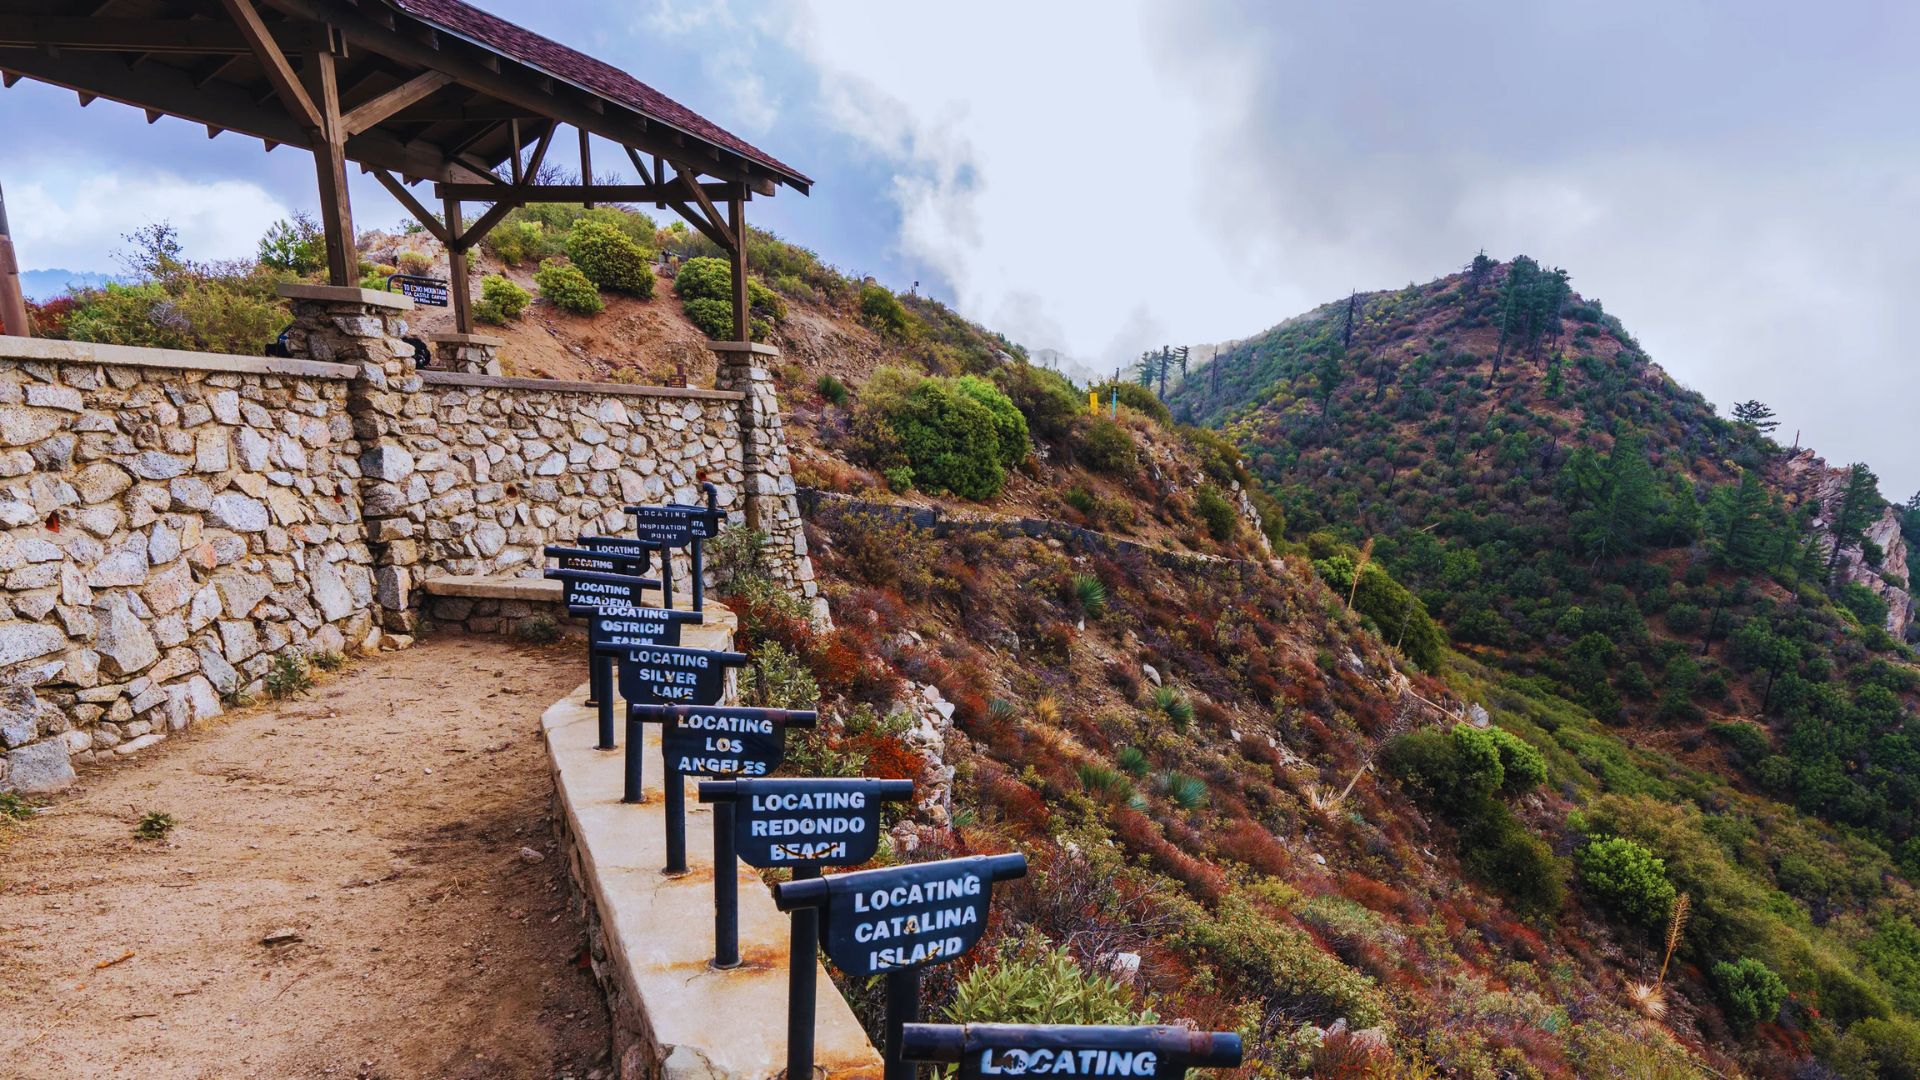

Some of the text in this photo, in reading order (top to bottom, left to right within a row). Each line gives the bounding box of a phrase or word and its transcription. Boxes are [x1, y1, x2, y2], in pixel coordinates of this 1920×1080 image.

[424, 287, 446, 295] MOUNTAIN
[637, 510, 687, 518] LOCATING
[639, 523, 687, 531] INSPIRATION
[596, 545, 640, 555] LOCATING
[567, 558, 613, 569] LOCATING
[574, 581, 631, 596] LOCATING
[569, 593, 633, 608] PASADENA
[598, 606, 669, 620] LOCATING
[600, 620, 664, 635] OSTRICH
[630, 650, 708, 669] LOCATING
[639, 668, 697, 686] SILVER
[652, 685, 694, 700] LAKE
[678, 714, 773, 734] LOCATING
[705, 737, 743, 753] LOS
[677, 757, 767, 776] ANGELES
[751, 791, 865, 812] LOCATING
[751, 816, 865, 837] REDONDO
[770, 841, 846, 861] BEACH
[854, 875, 981, 913] LOCATING
[854, 905, 977, 943] CATALINA
[869, 936, 963, 971] ISLAND
[980, 1048, 1157, 1077] LOCATING
